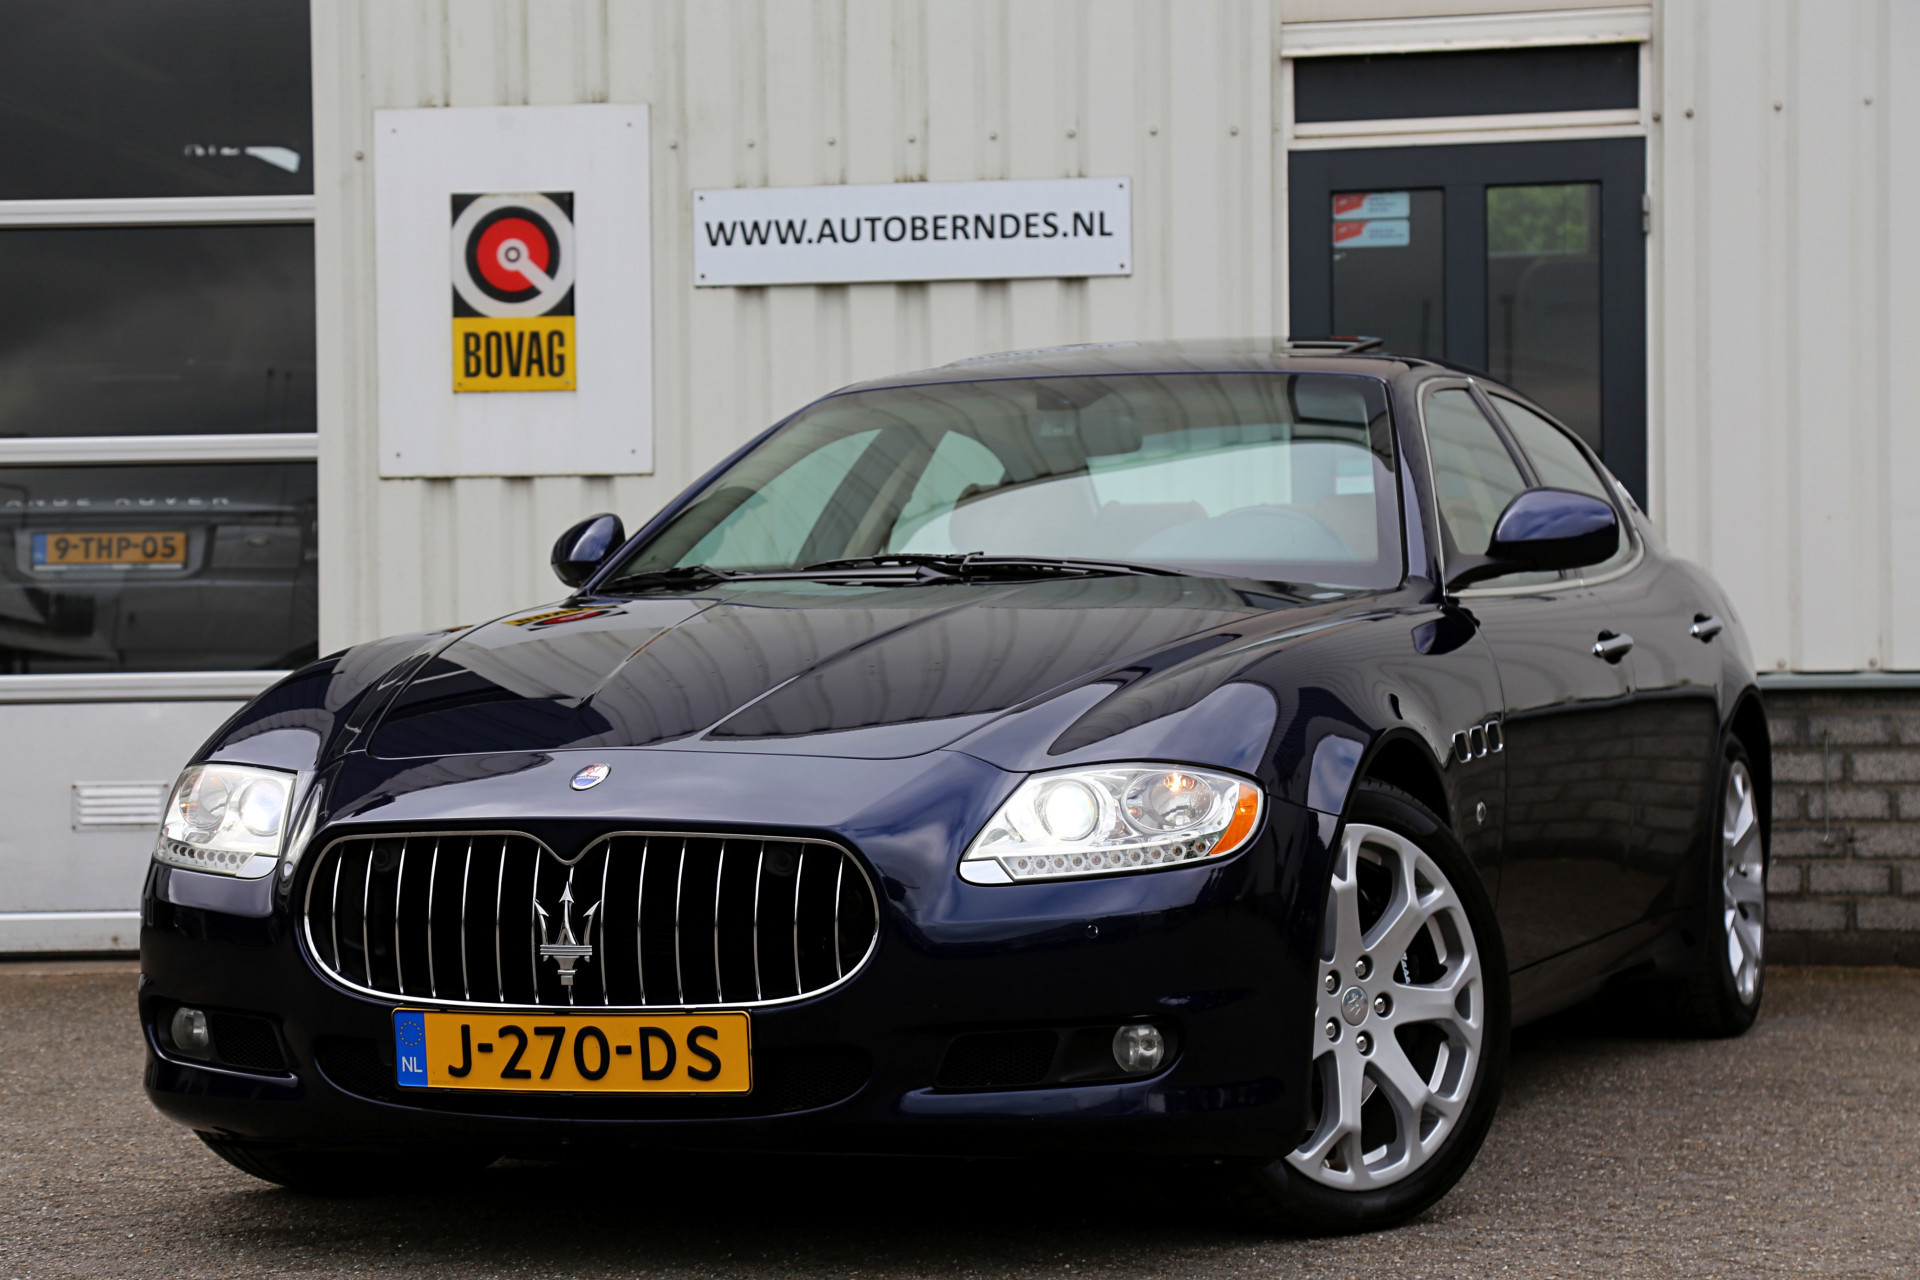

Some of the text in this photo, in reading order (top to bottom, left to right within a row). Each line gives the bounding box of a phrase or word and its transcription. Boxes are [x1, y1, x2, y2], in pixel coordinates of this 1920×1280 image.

[705, 211, 1114, 247] WWW.AUTOBERNDES.NL
[463, 330, 566, 378] BOVAG
[54, 536, 177, 560] 9-THP-05
[402, 1056, 423, 1073] NL
[448, 1024, 722, 1081] J-270-DS
